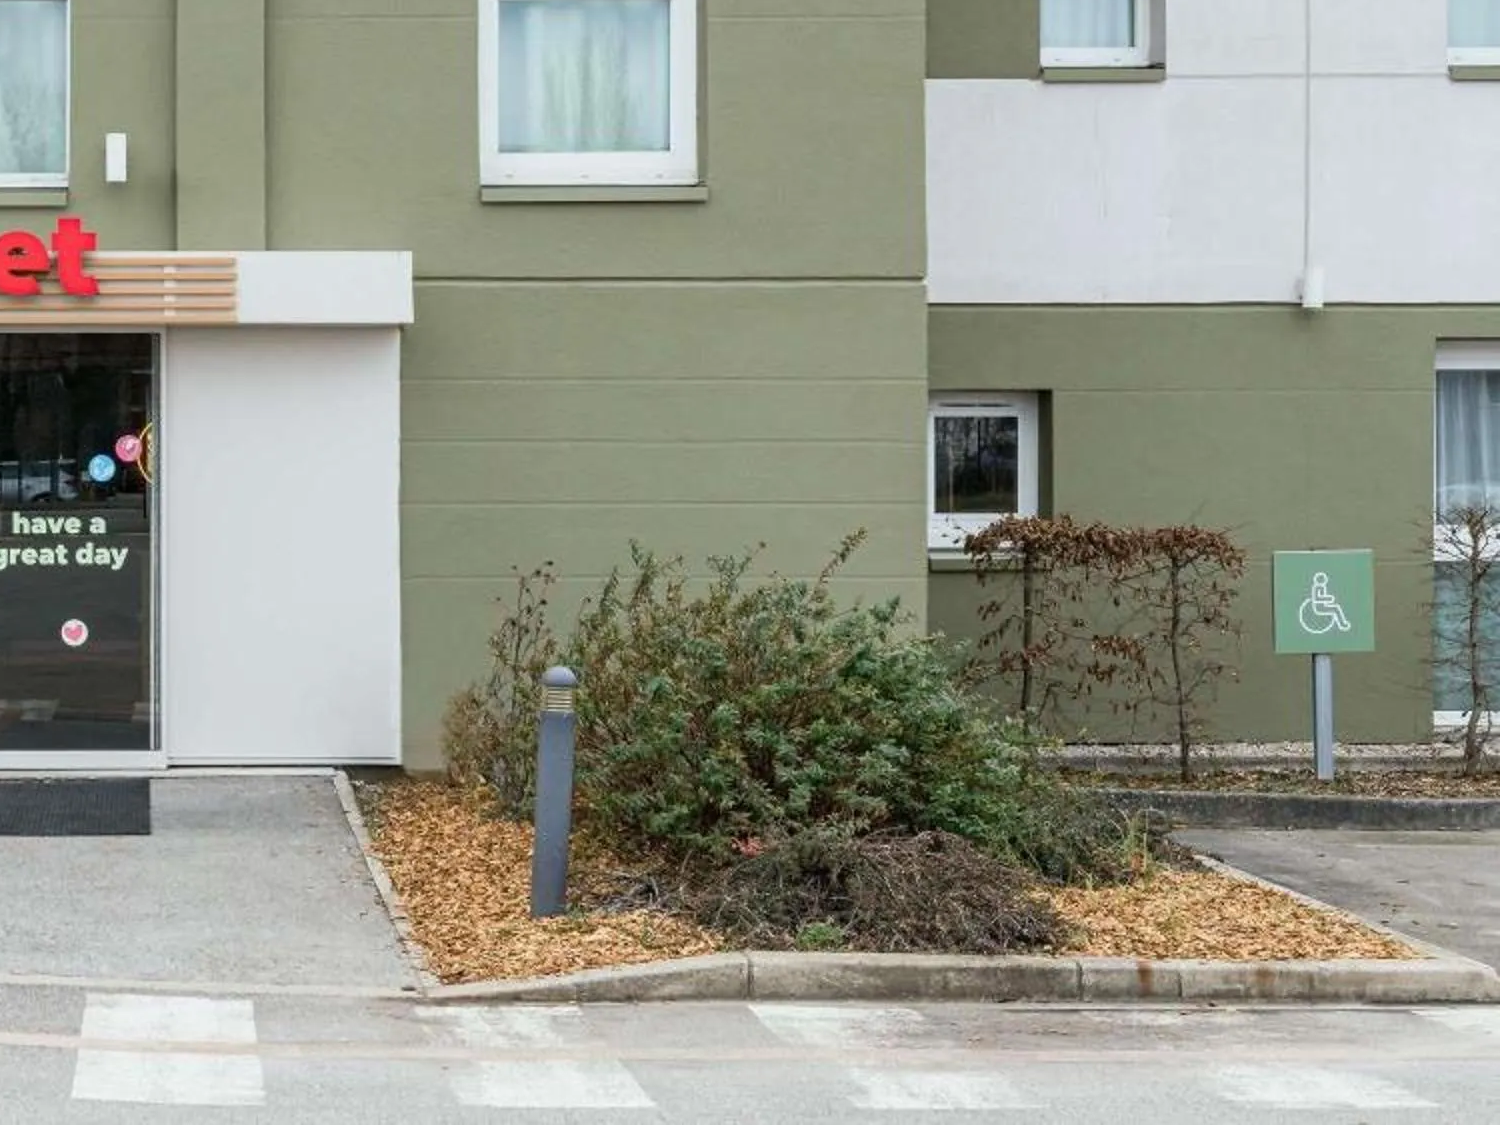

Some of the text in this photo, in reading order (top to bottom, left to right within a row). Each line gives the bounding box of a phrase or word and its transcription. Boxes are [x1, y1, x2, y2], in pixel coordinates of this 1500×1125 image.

[11, 511, 107, 534] have a
[75, 542, 129, 570] day
